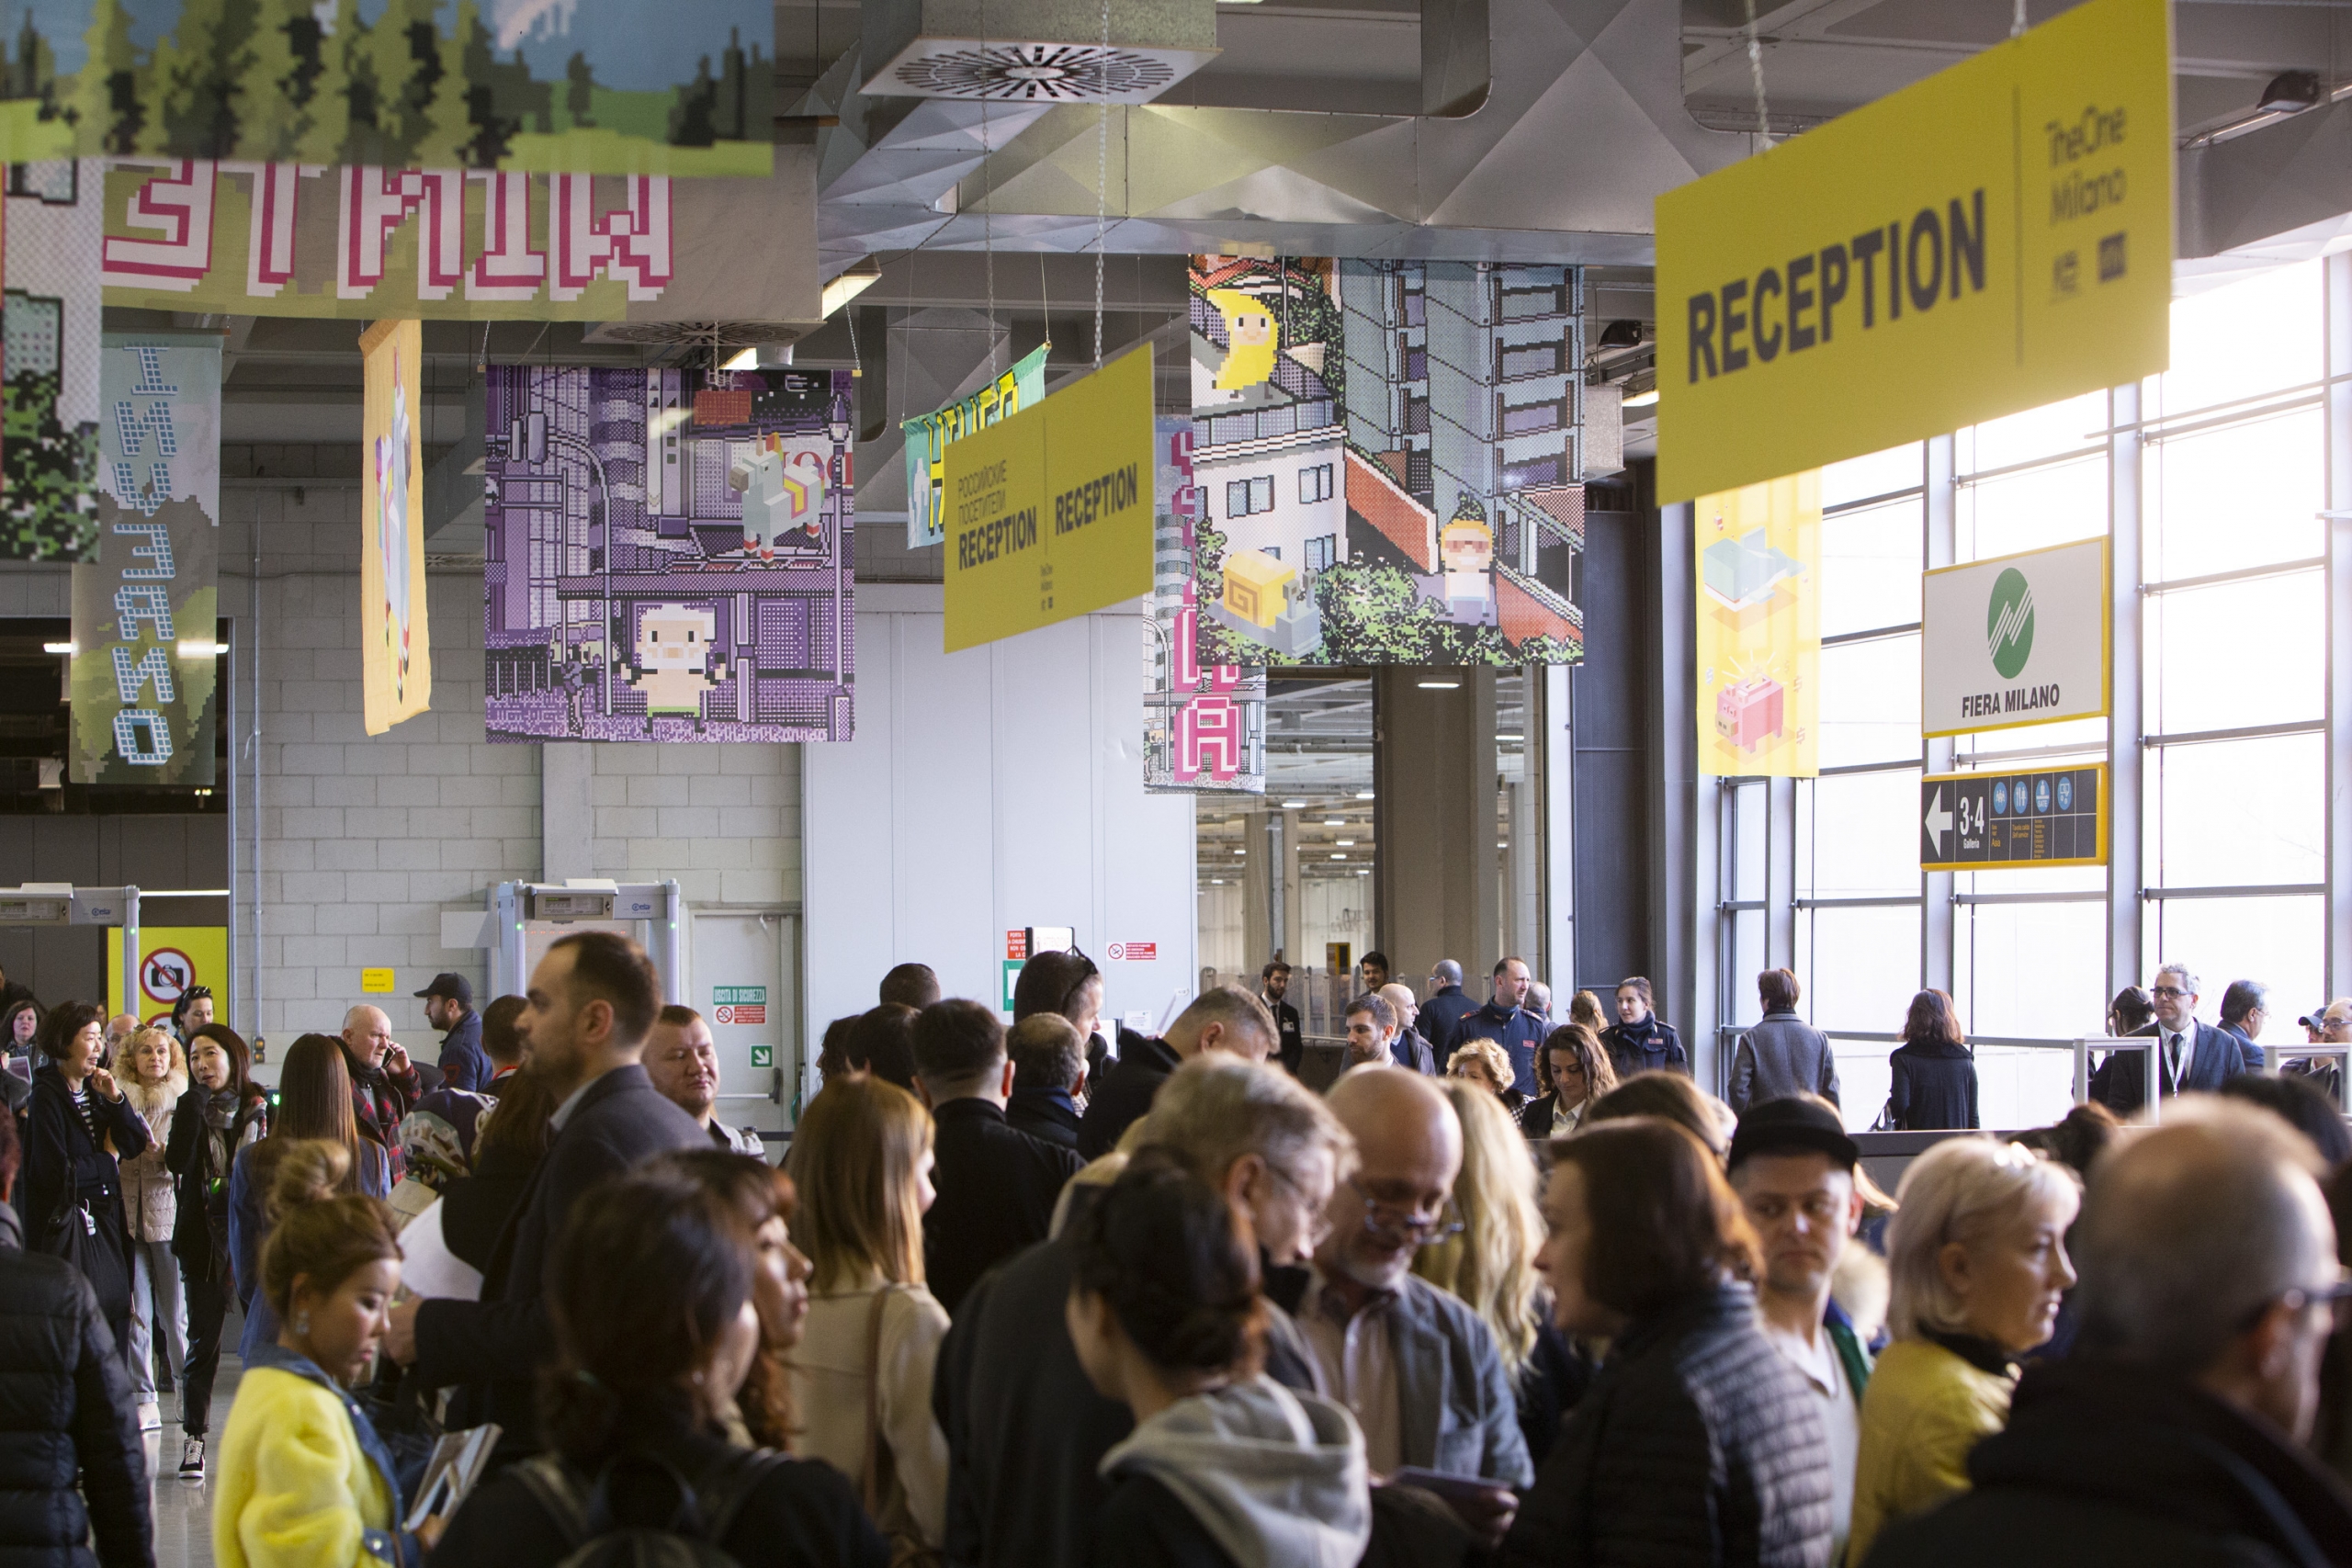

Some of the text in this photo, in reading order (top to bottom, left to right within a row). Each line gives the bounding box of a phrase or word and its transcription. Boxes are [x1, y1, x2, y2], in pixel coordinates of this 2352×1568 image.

[1687, 187, 1986, 385] RECEPTION
[1056, 462, 1137, 536] RECEPTION
[958, 505, 1037, 571] RECEPTION
[1962, 683, 2060, 718] FIERA MILANO
[1963, 838, 1980, 849] Galleria
